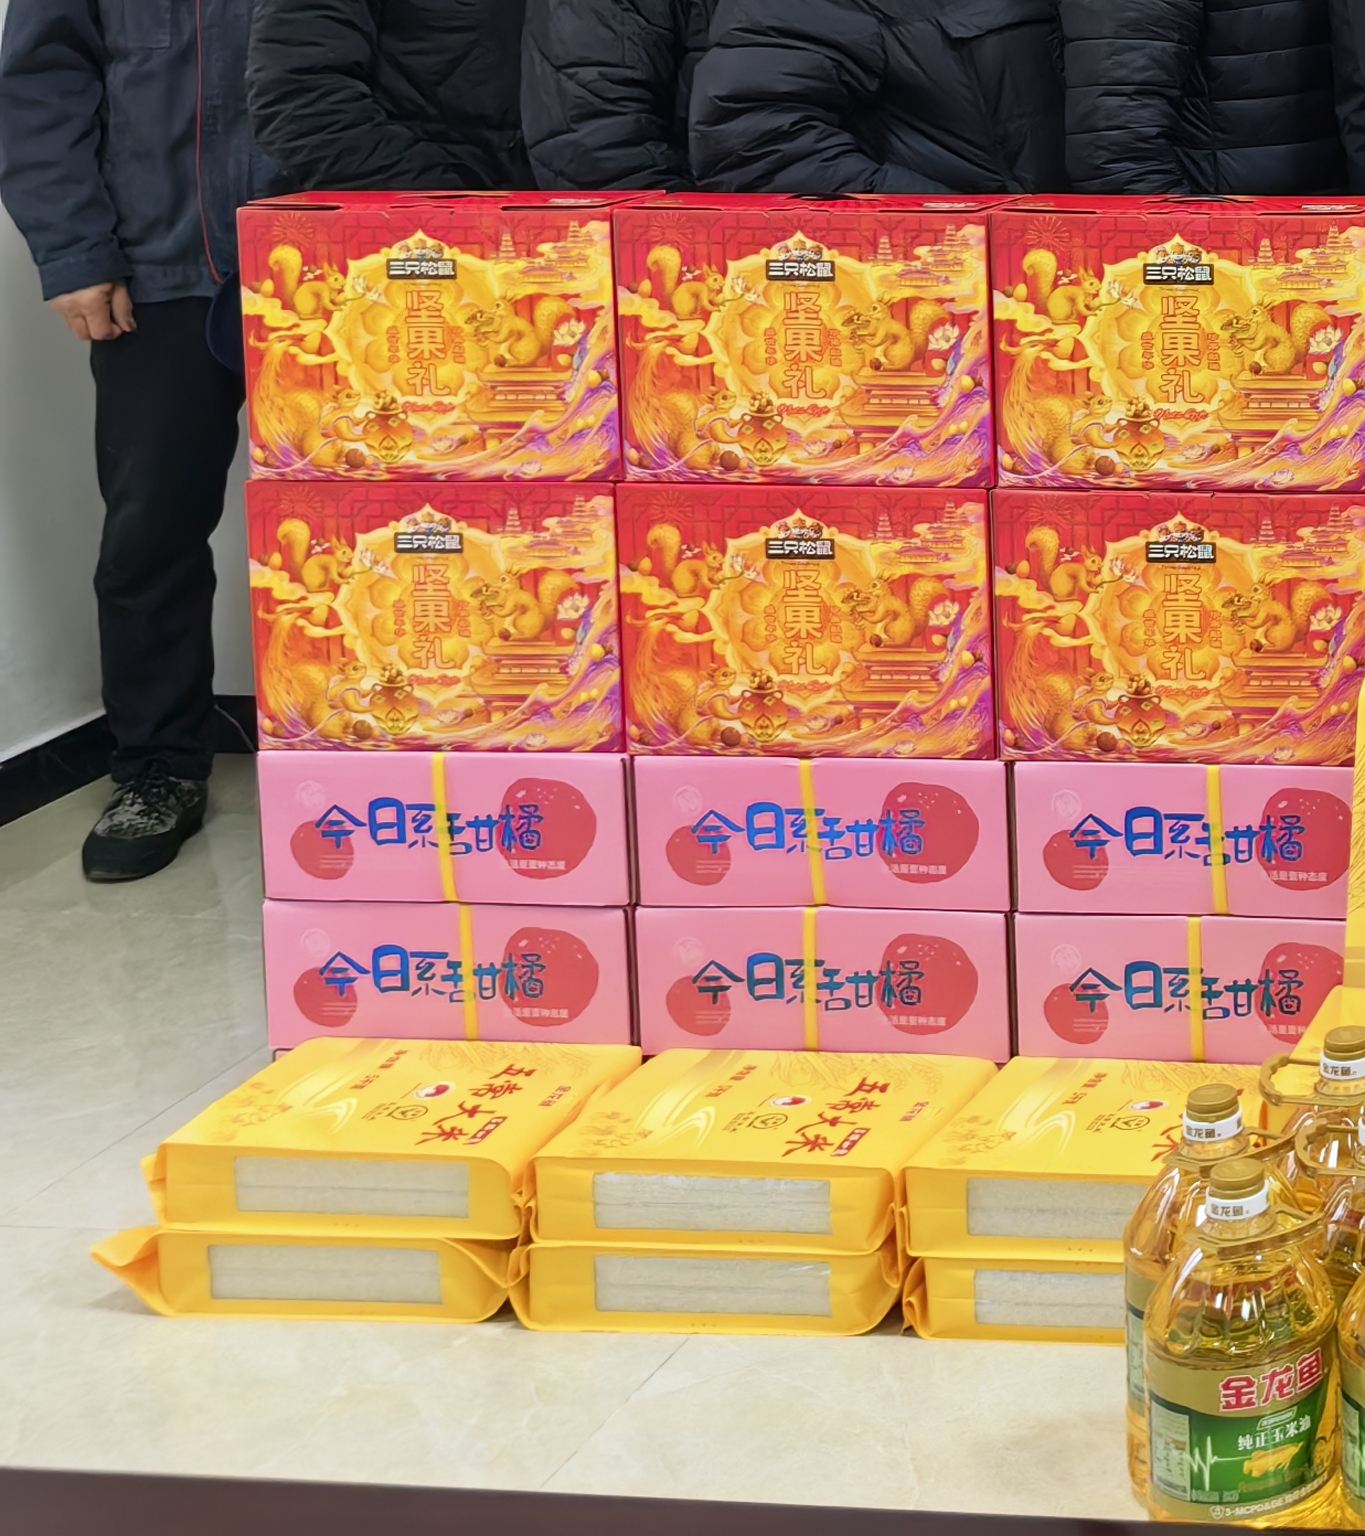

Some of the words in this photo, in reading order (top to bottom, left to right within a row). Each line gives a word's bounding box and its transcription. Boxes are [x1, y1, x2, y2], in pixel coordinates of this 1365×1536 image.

[390, 261, 454, 276] 三只松鼠
[768, 262, 832, 277] 三只松鼠
[1146, 266, 1212, 282] 三只松鼠
[406, 291, 450, 396] 坚果礼
[782, 292, 827, 399] 坚果礼
[1160, 296, 1205, 403] 坚果礼
[398, 535, 461, 550] 三只松鼠
[768, 540, 832, 555] 三只松鼠
[1149, 544, 1213, 559] 三只松鼠
[411, 564, 455, 669] 坚果礼
[783, 570, 827, 675] 坚果礼
[1162, 574, 1207, 681] 坚果礼
[416, 1064, 537, 1146] 五常大米
[782, 1077, 890, 1157] 五常大米
[1211, 1203, 1243, 1217] 金龙鱼
[1220, 1348, 1323, 1412] 金龙鱼
[1237, 1415, 1311, 1452] 纯正玉米油
